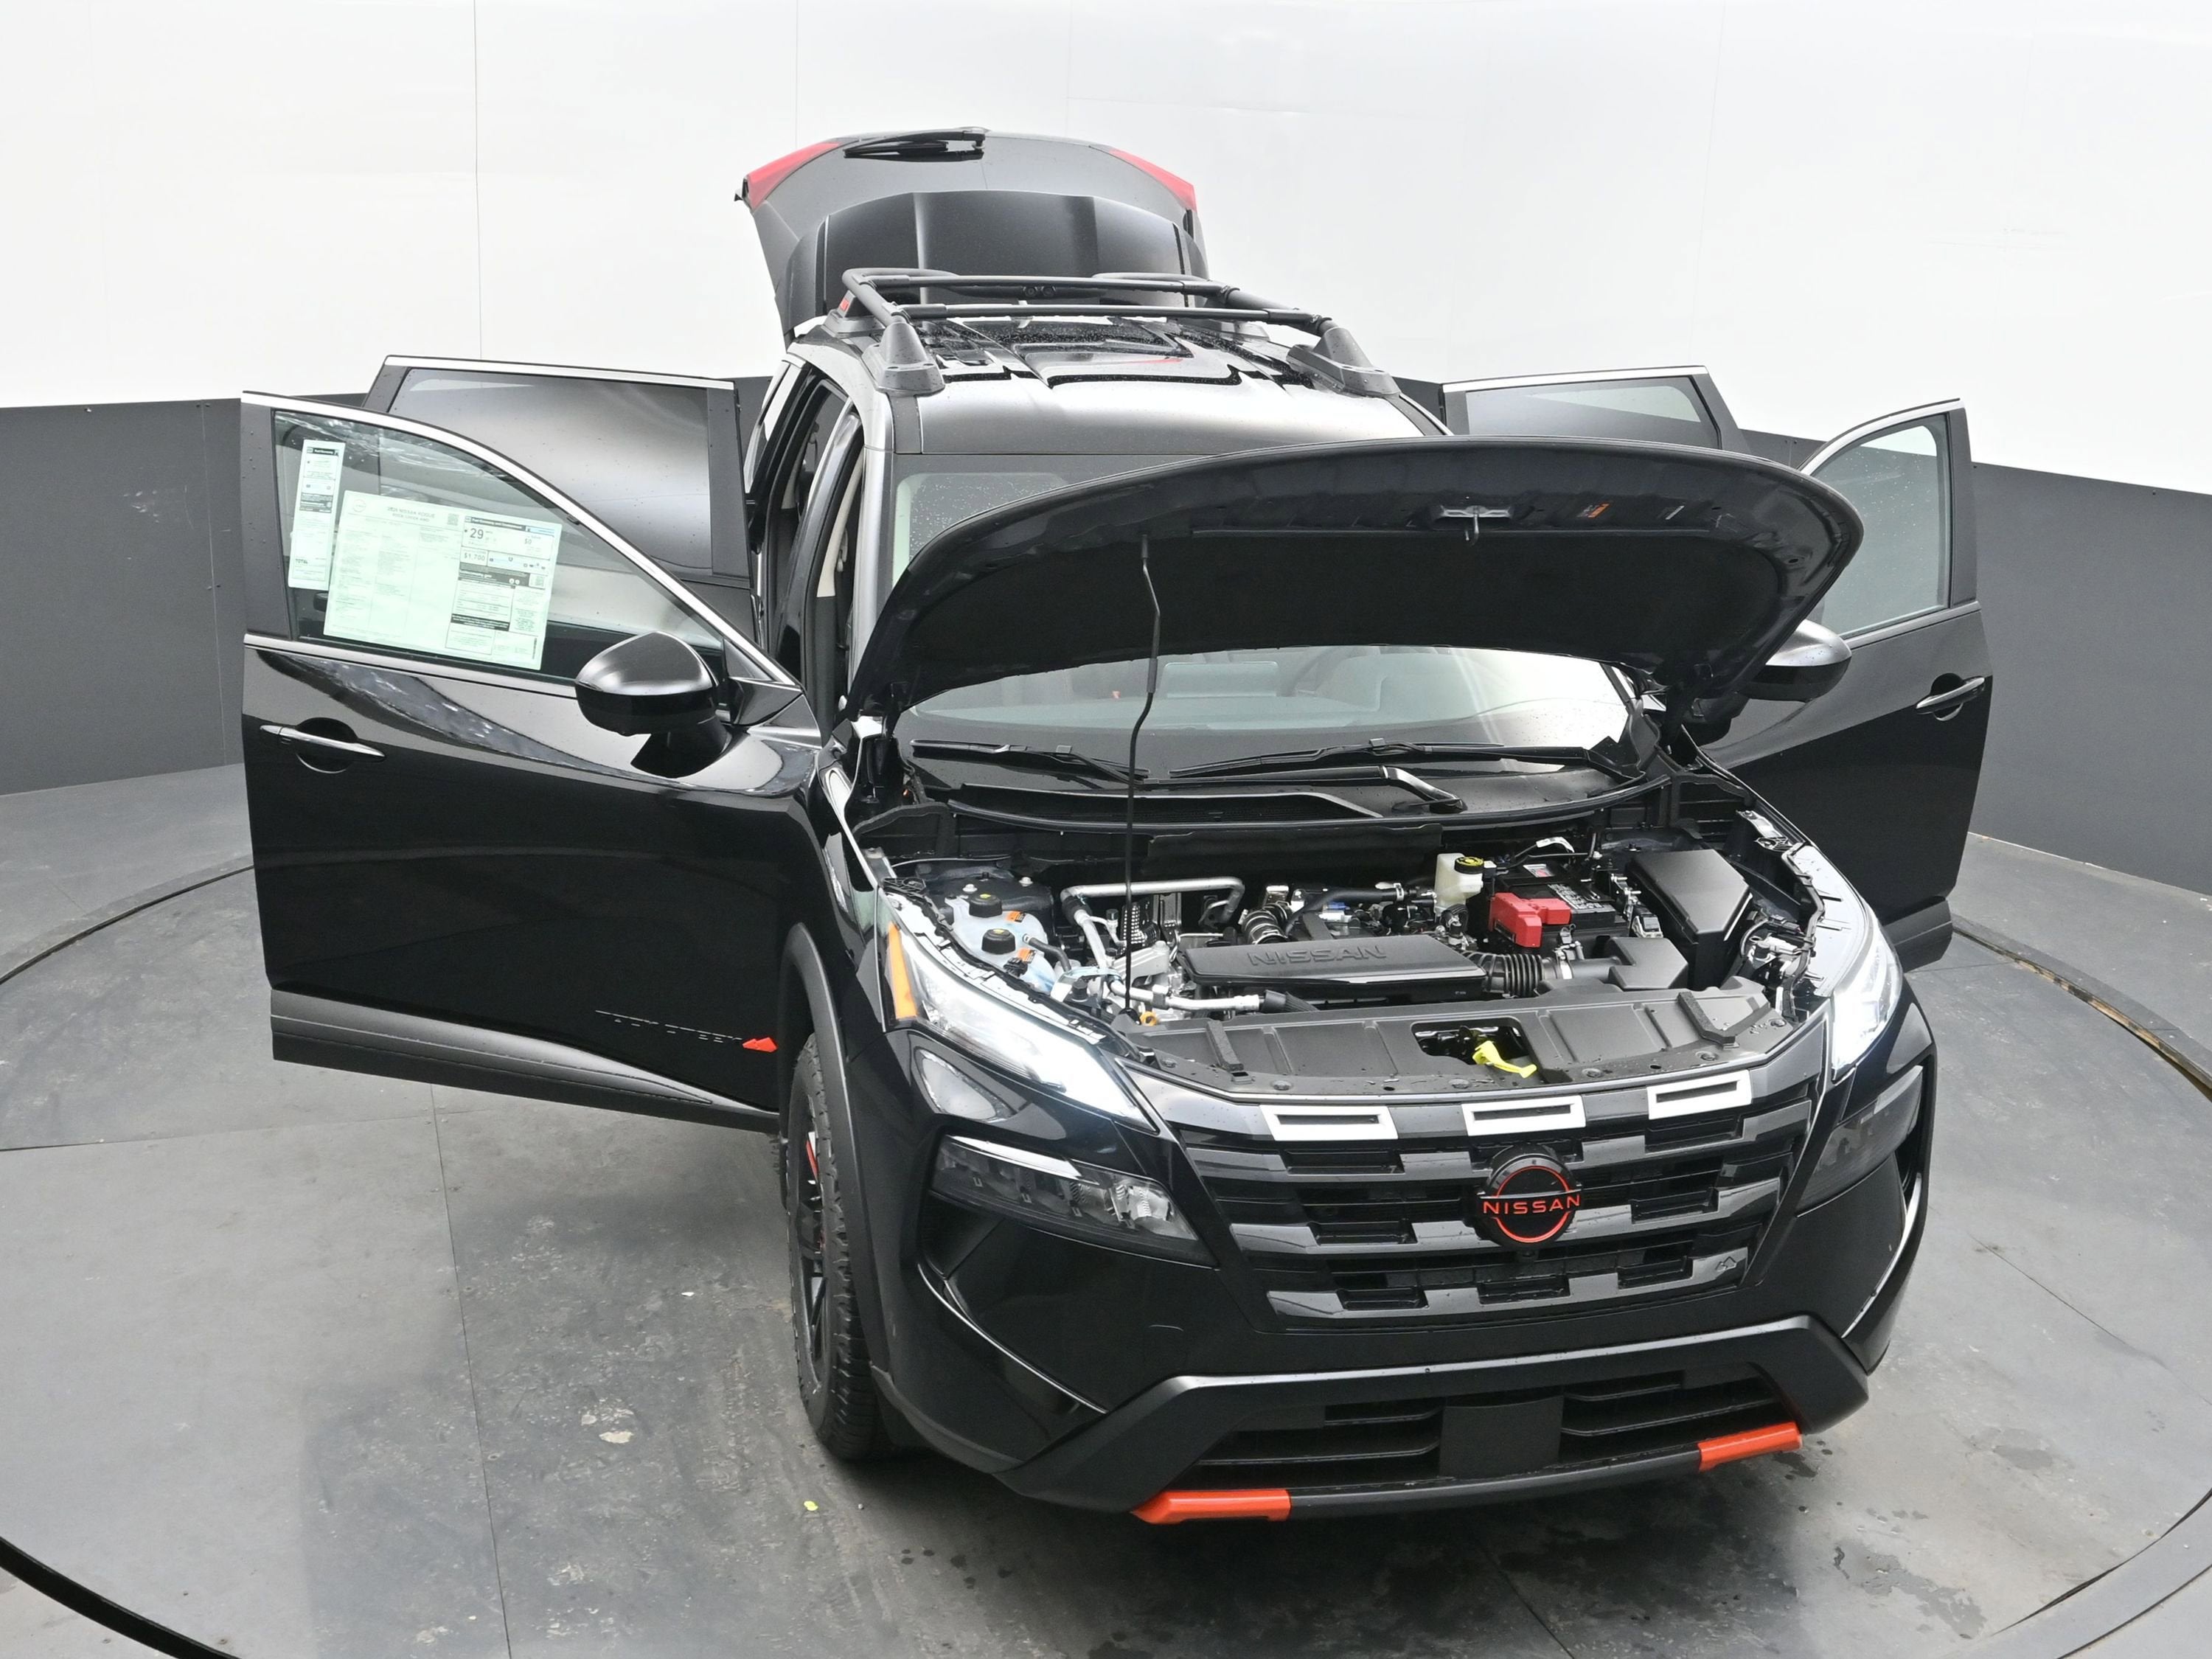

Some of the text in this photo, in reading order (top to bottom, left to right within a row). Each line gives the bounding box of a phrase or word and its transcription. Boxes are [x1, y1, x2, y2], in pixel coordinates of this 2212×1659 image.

[469, 527, 484, 540] 29
[1247, 945, 1387, 966] NISSAN
[1483, 1194, 1580, 1214] NISSAN
